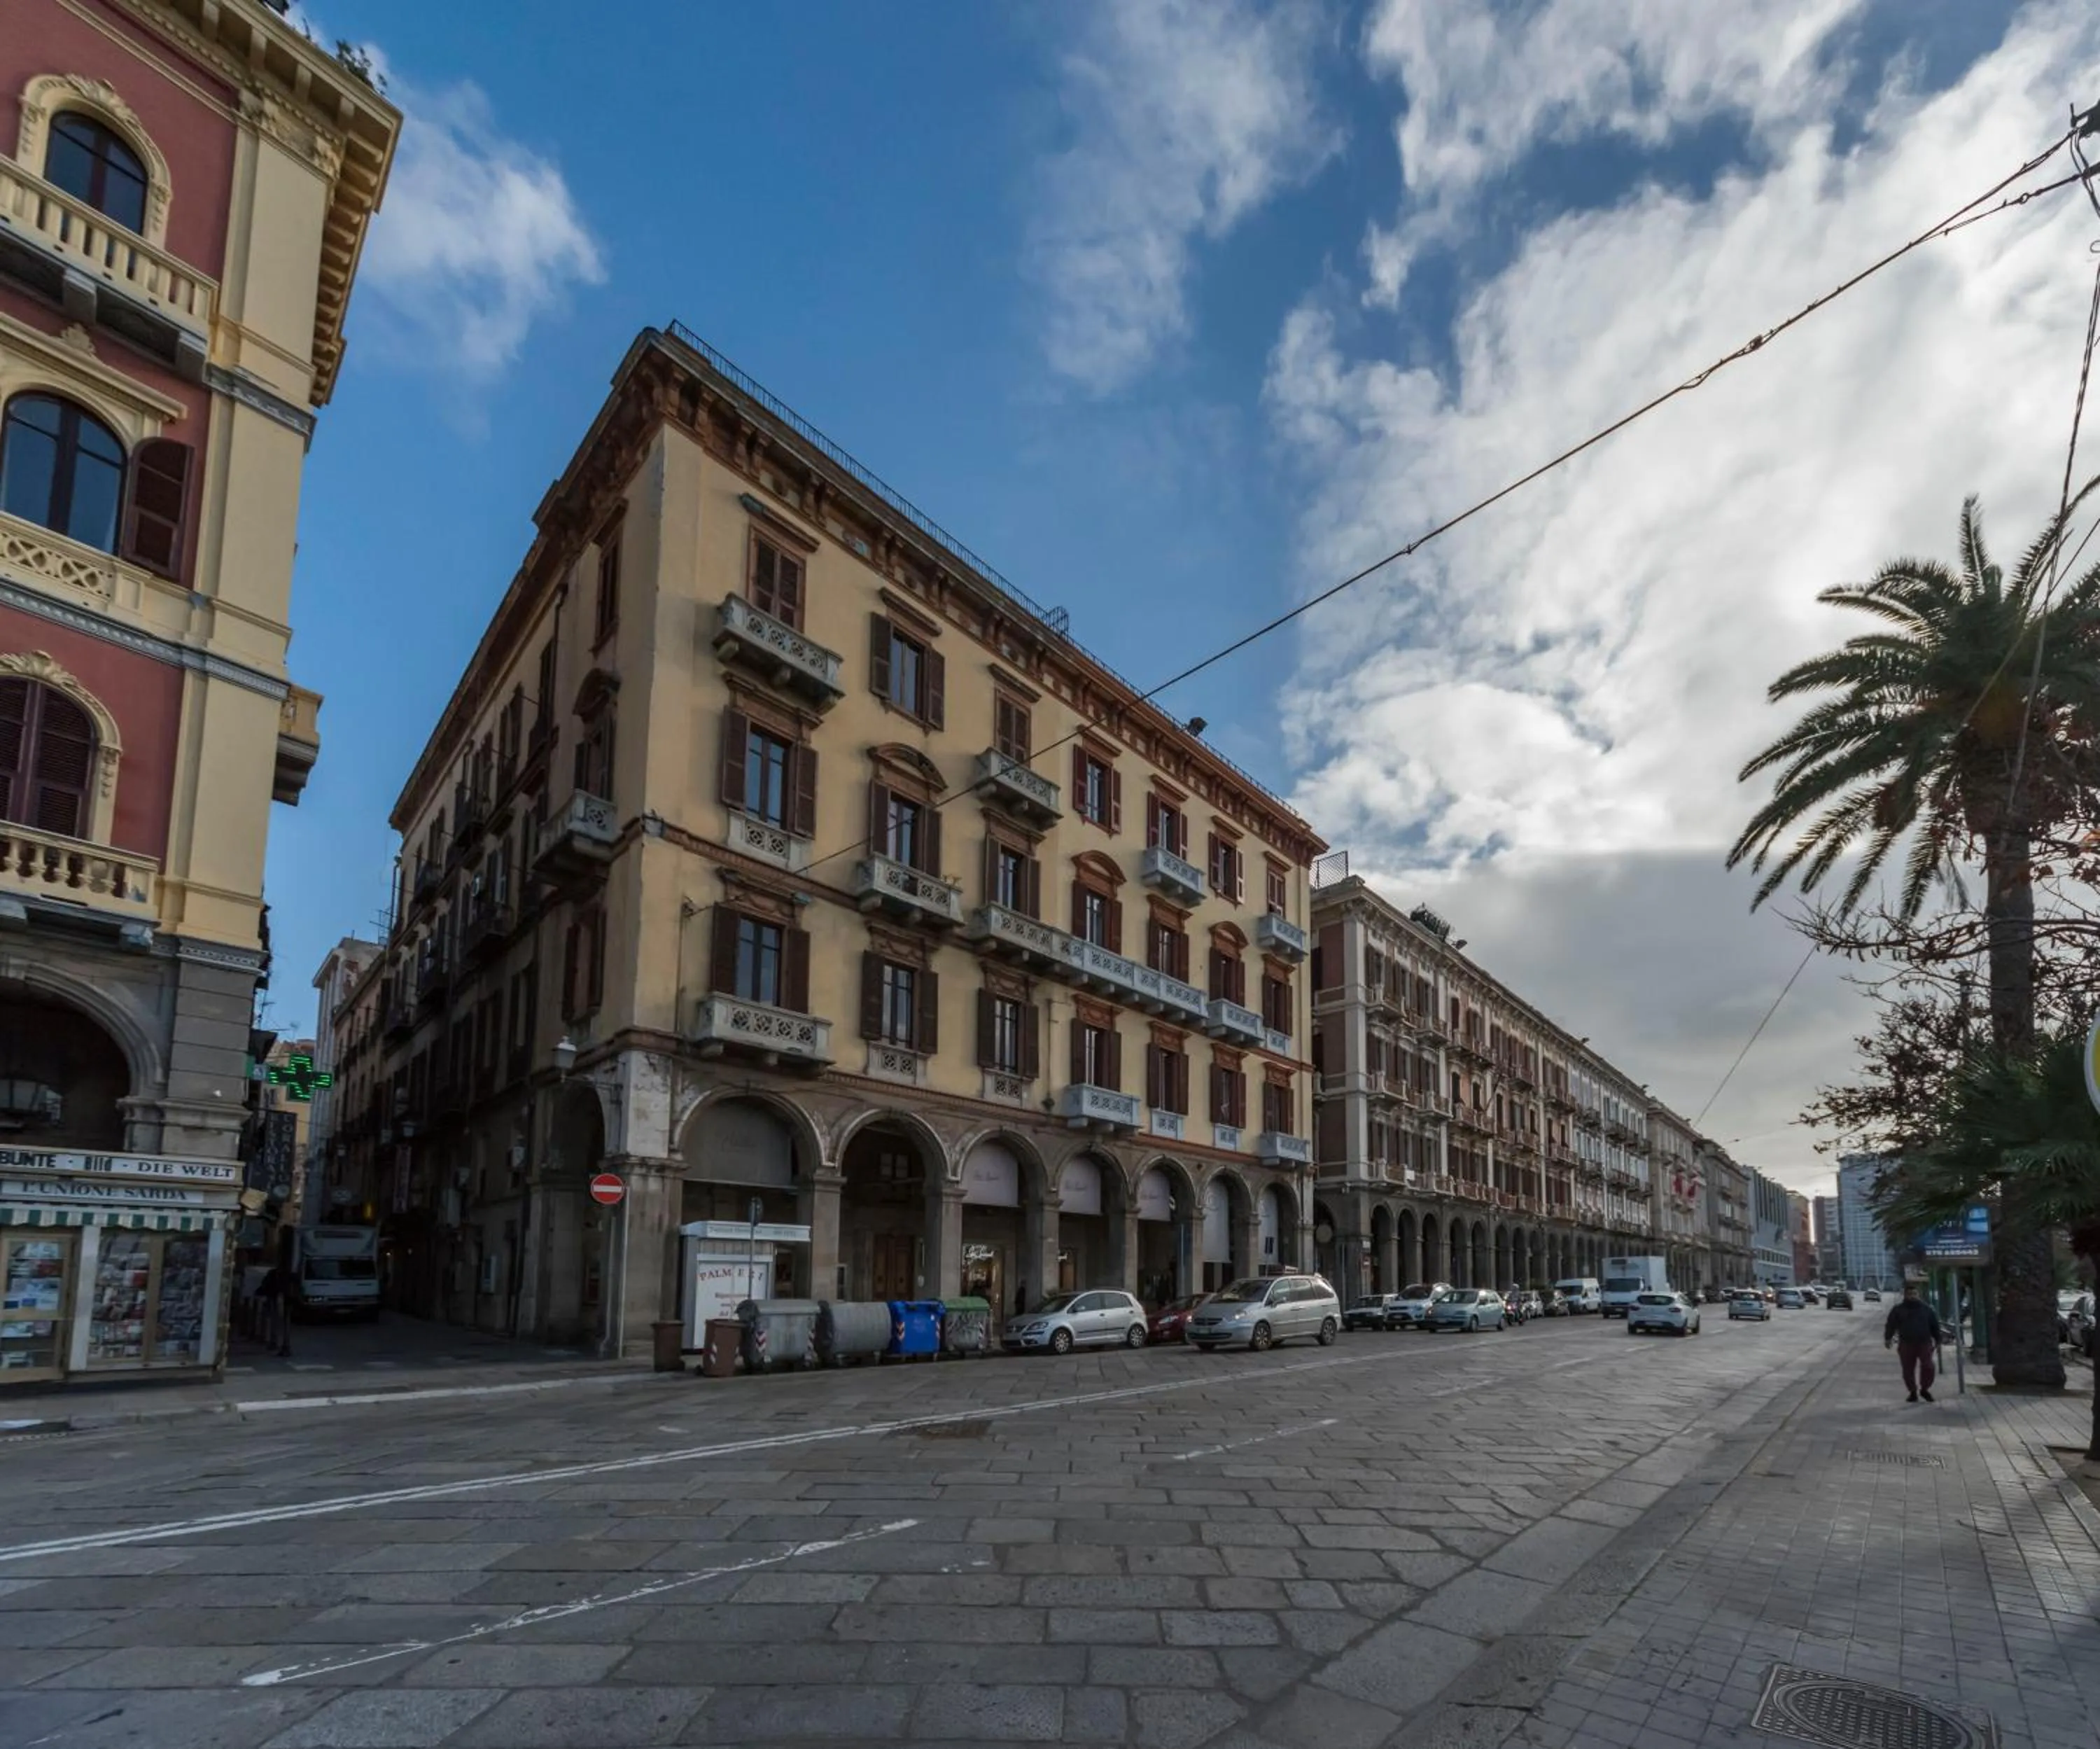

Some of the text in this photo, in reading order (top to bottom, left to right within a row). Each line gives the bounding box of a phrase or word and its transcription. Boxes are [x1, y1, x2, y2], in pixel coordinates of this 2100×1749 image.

[0, 1150, 56, 1168] BUNTE
[137, 1162, 174, 1173] DIE
[181, 1165, 234, 1178] WELT
[22, 1181, 187, 1200] L'UNIONE SARDA
